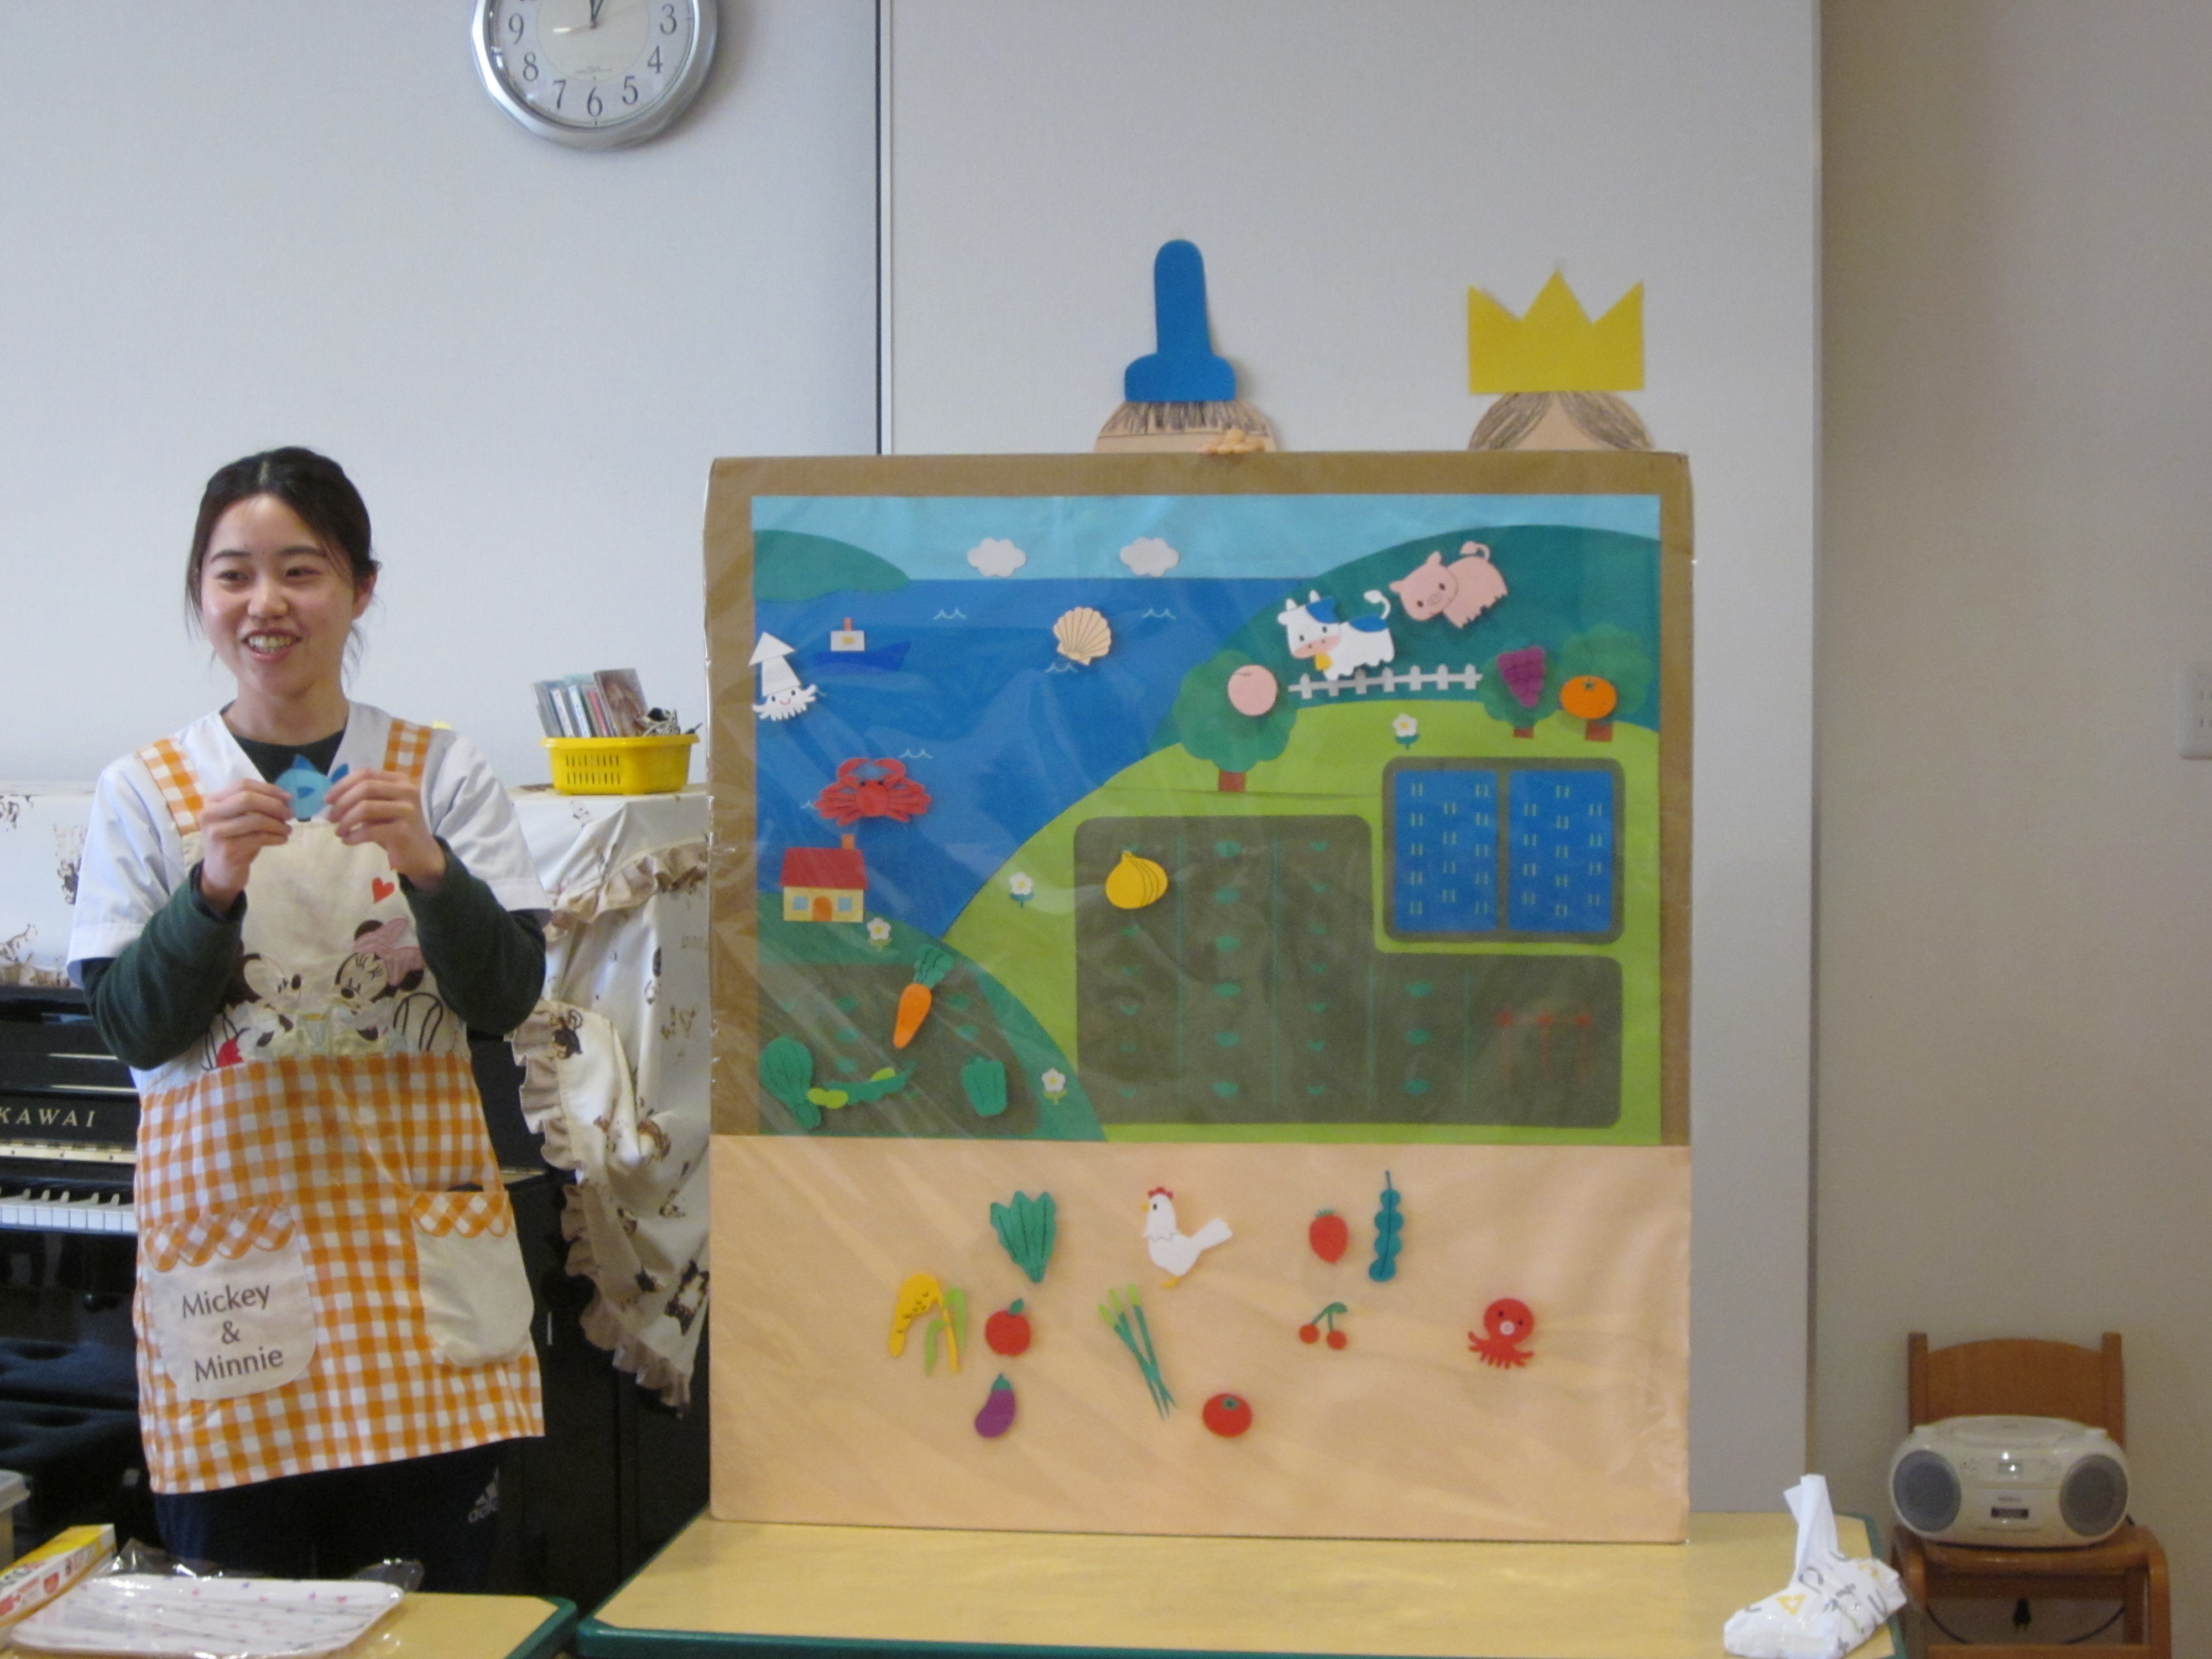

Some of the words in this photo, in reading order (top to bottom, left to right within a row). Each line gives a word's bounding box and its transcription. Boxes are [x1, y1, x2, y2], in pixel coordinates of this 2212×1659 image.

[508, 13, 524, 44] 9
[660, 4, 677, 34] 3
[523, 51, 539, 81] 8
[648, 45, 663, 74] 4
[553, 80, 566, 109] 7
[587, 86, 603, 116] 6
[622, 75, 639, 105] 5
[0, 1107, 96, 1127] KAWAI
[182, 1284, 270, 1318] Mickey
[221, 1320, 241, 1344] &
[194, 1346, 284, 1382] Minnie
